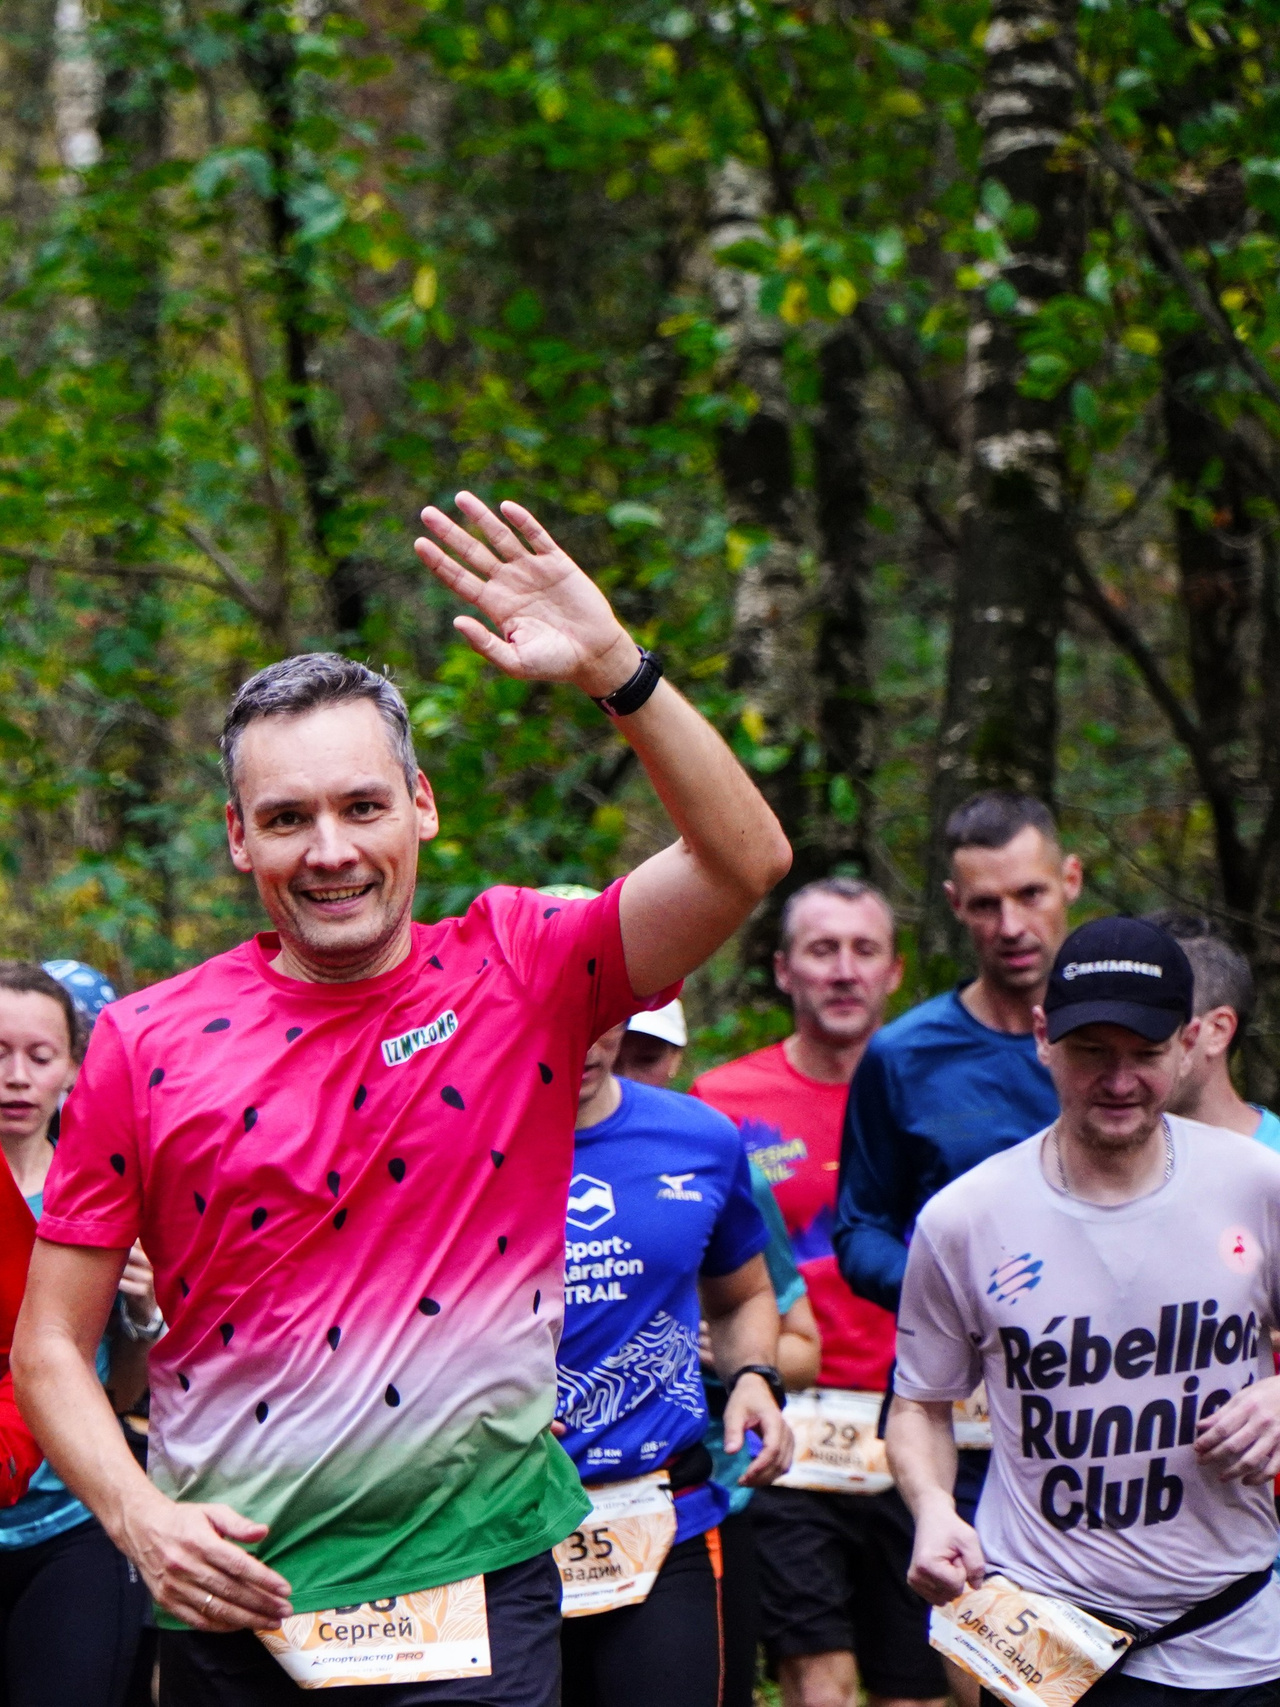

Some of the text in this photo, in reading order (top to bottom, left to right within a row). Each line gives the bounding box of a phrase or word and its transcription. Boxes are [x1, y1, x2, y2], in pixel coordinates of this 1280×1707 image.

[564, 1281, 628, 1306] TRAIL
[998, 1298, 1258, 1391] Rébellion
[1020, 1371, 1255, 1460] Runni
[822, 1420, 858, 1450] 29
[1040, 1456, 1183, 1532] Club
[570, 1527, 613, 1562] 35
[318, 1616, 414, 1645] Сергей
[1005, 1608, 1039, 1637] 5
[395, 1651, 426, 1662] PRO
[957, 1609, 1044, 1685] Александр
